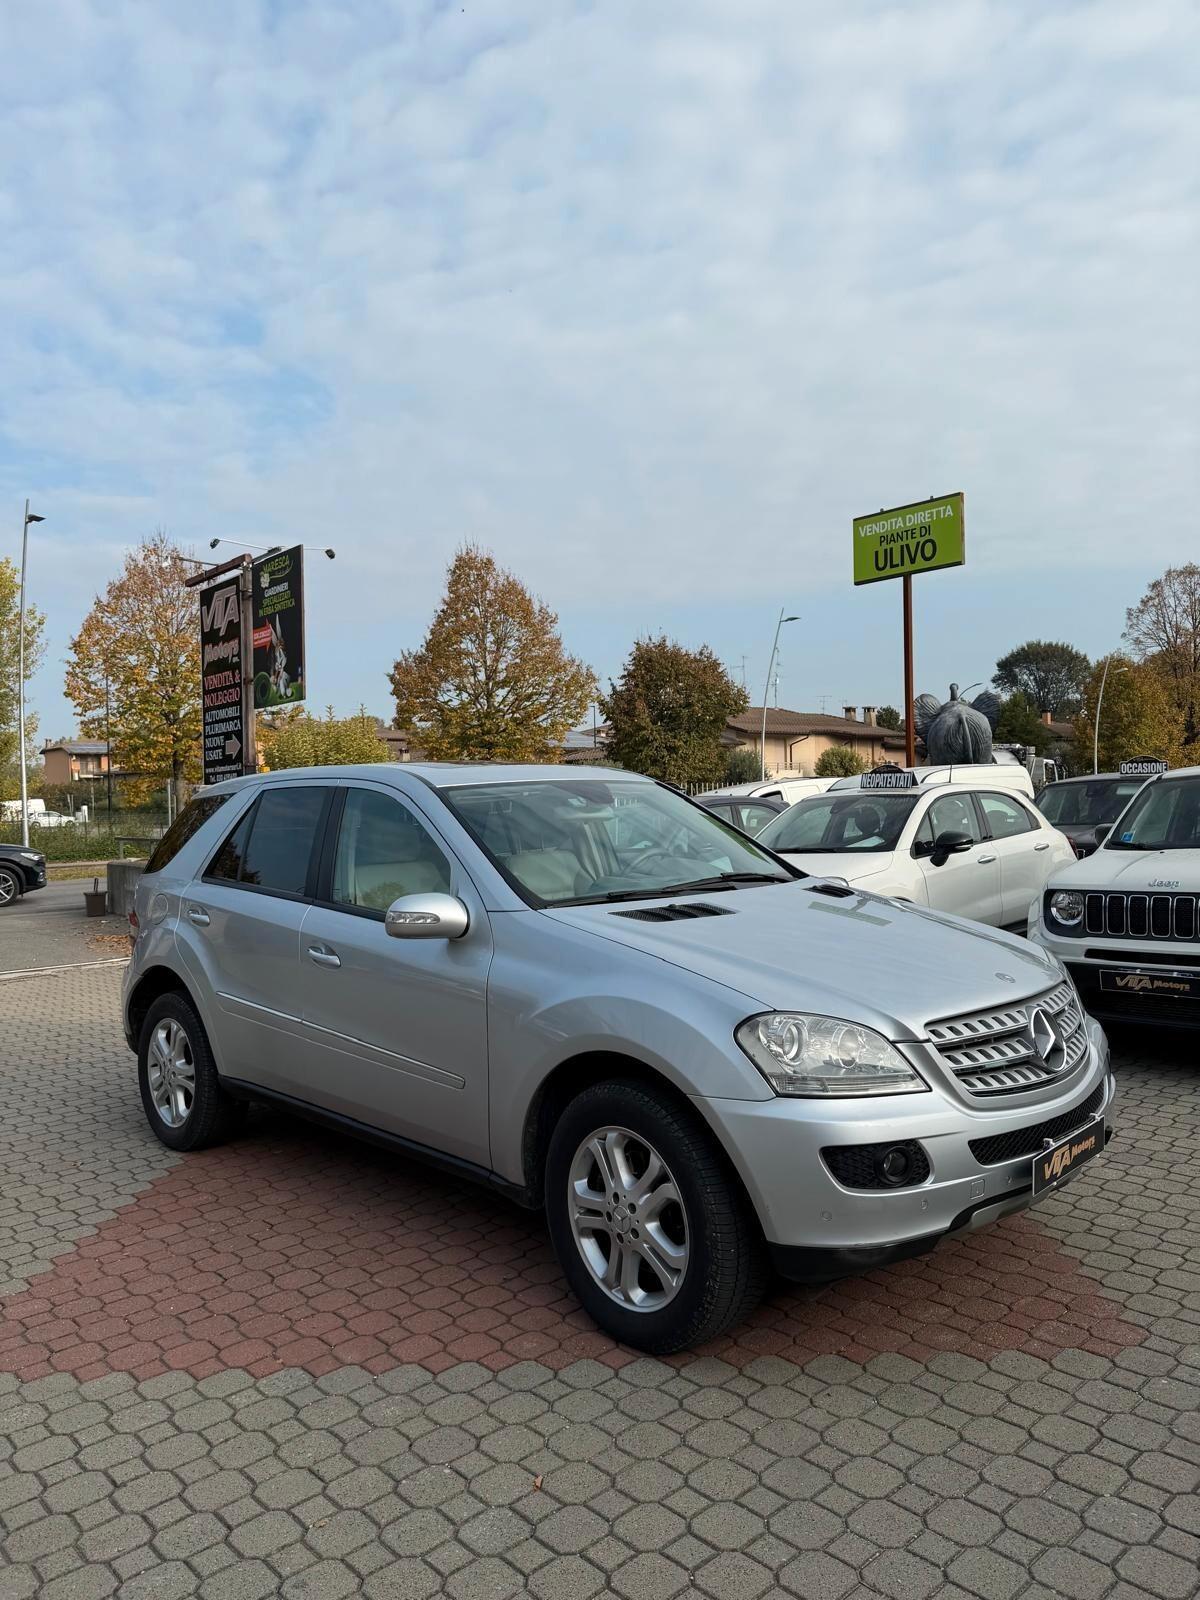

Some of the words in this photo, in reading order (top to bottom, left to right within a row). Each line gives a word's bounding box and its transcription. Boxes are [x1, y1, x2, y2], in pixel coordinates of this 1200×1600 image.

[859, 517, 904, 537] VENDITA
[906, 504, 954, 526] DIRETTA
[880, 527, 917, 547] PIANTE
[920, 524, 931, 538] DI
[874, 538, 937, 572] ULIVO
[202, 585, 240, 636] VITA
[204, 637, 240, 671] Motors
[204, 670, 233, 690] VENDITA
[235, 669, 241, 683] &
[204, 687, 240, 708] NOLEGGIO
[205, 705, 241, 722] AUTOMOBILI
[205, 719, 241, 736] PLURIMARCA
[205, 735, 224, 749] NUOVE
[205, 749, 223, 761] USATE
[1121, 762, 1167, 774] OCCASIONE
[861, 773, 912, 788] NEOPATENTATI
[1148, 878, 1180, 889] Jeep
[1115, 974, 1152, 991] VITA
[1153, 978, 1190, 991] Motors
[1044, 1144, 1071, 1180] VITA
[1071, 1136, 1095, 1162] Motors
